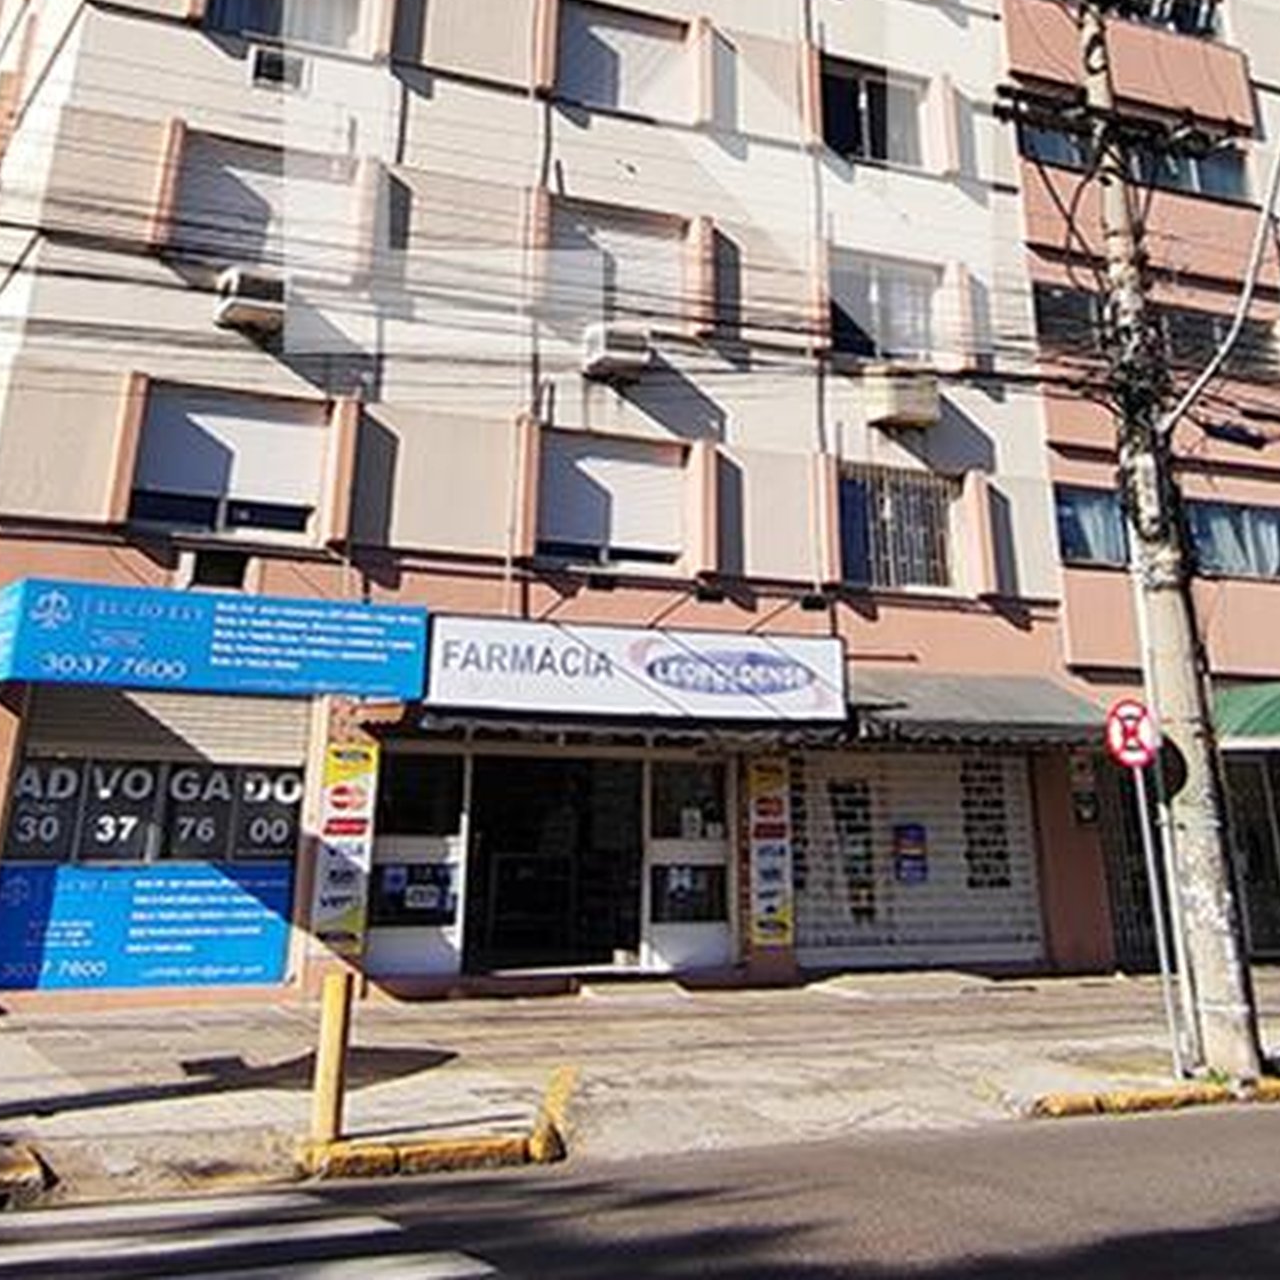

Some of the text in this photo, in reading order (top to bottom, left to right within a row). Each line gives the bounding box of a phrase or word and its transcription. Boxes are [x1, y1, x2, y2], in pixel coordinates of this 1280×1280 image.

[41, 652, 111, 675] 3037
[122, 656, 188, 681] 7600
[441, 637, 615, 678] FARMÁCIA
[16, 815, 290, 844] 30 37 76 00
